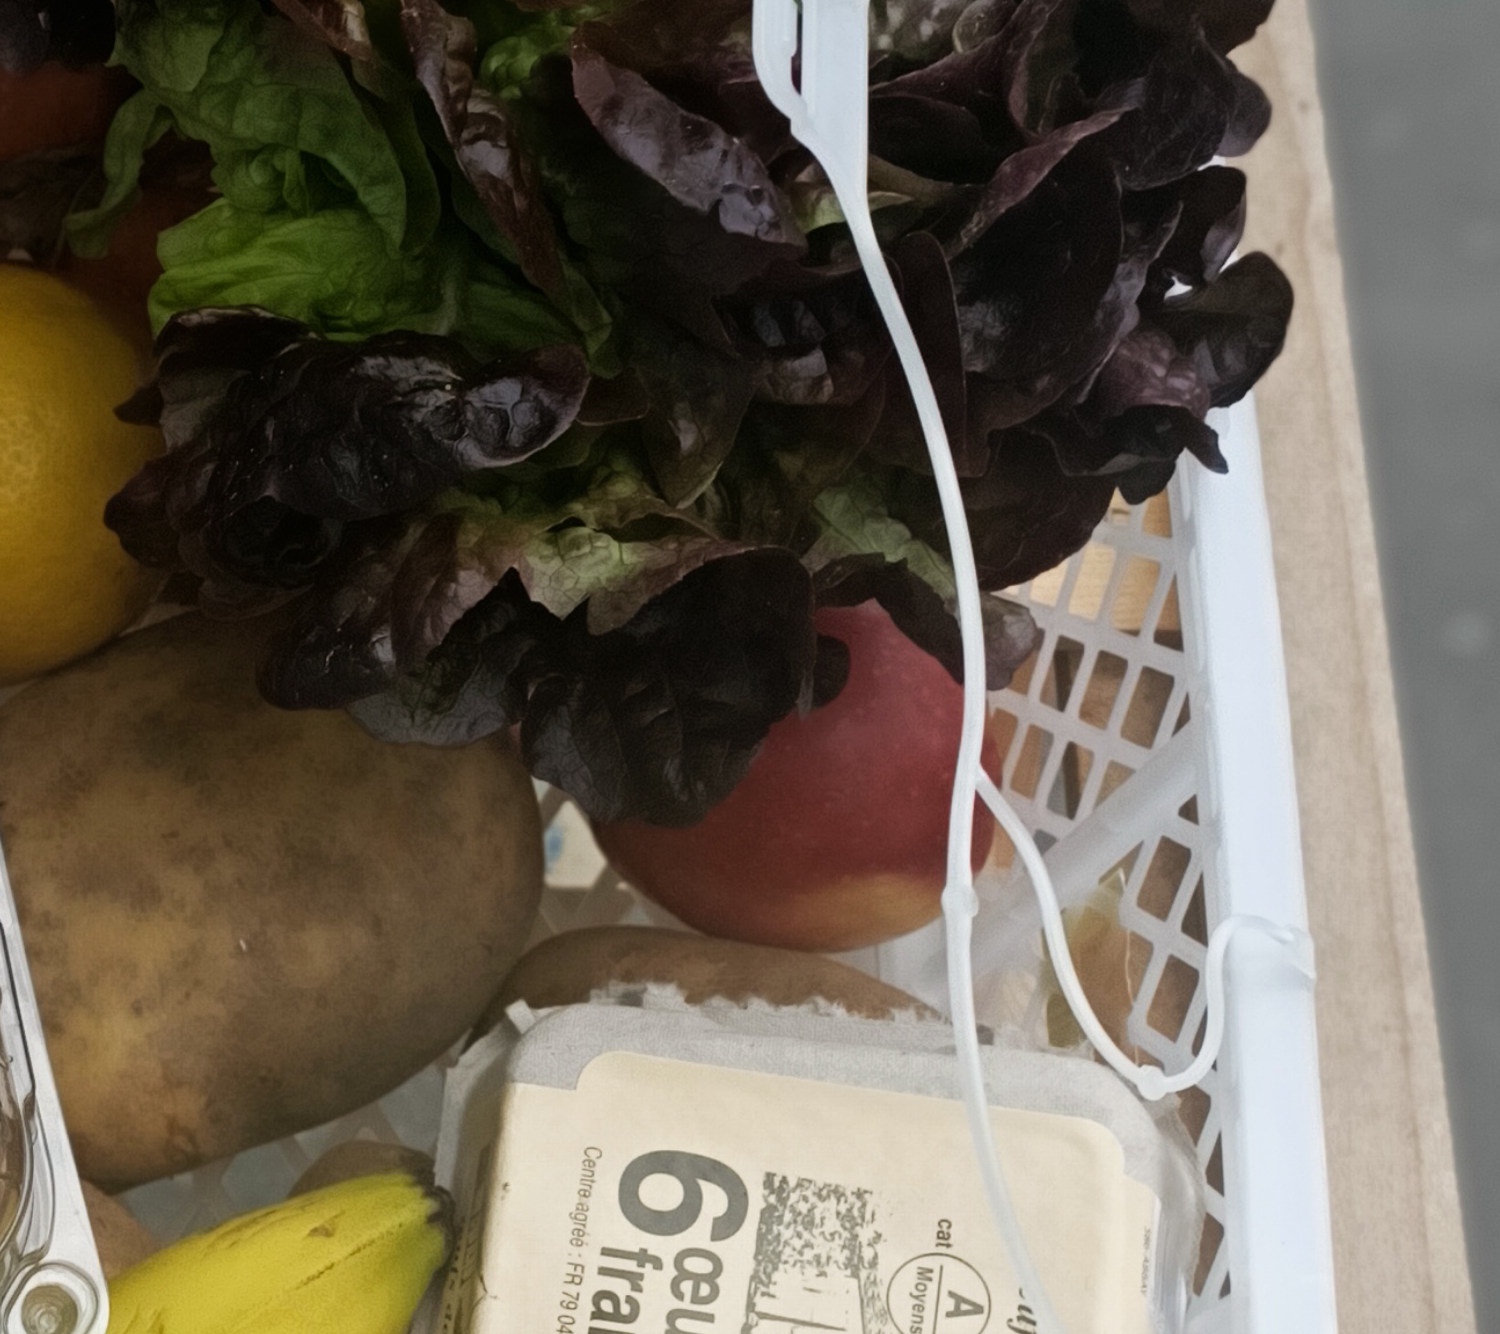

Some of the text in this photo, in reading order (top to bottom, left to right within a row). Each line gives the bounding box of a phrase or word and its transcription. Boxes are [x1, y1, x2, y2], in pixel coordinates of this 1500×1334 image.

[577, 1146, 603, 1197] Centre
[618, 1150, 749, 1242] 6
[569, 1203, 590, 1247] agréé
[563, 1262, 584, 1286] FR
[935, 1219, 984, 1320] cat A
[559, 1291, 580, 1310] 79
[909, 1266, 934, 1334] Moyens
